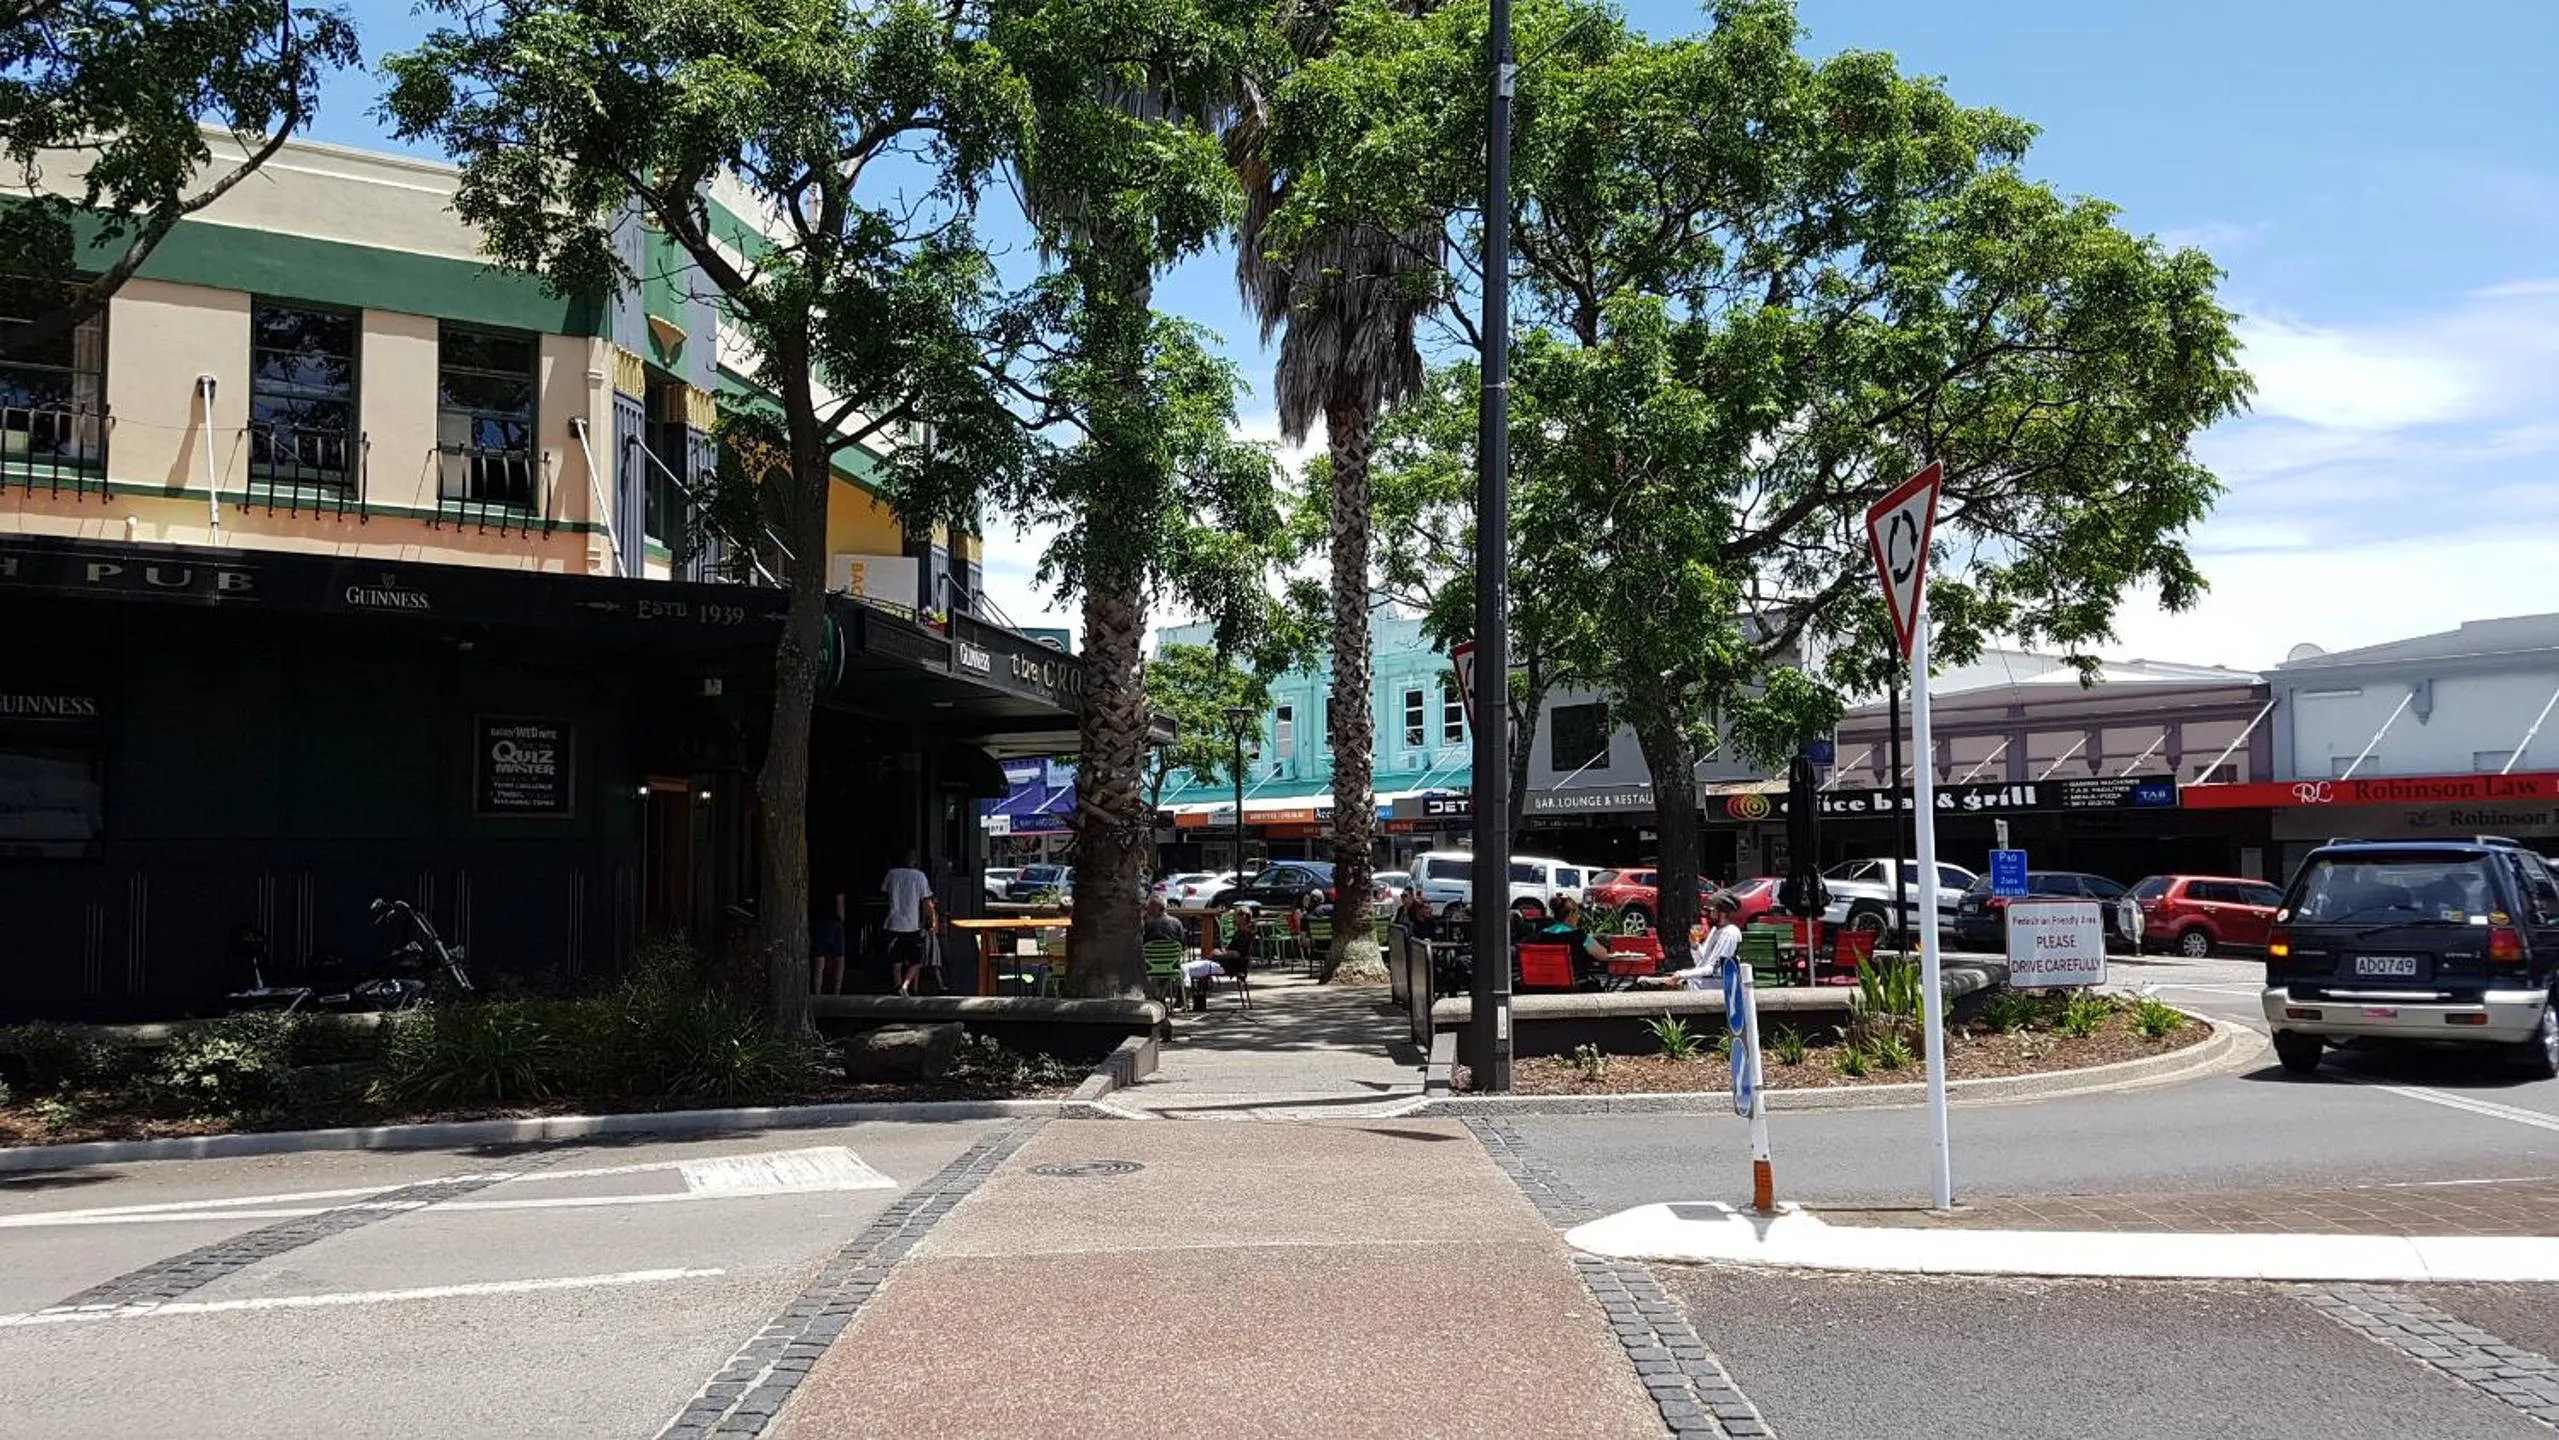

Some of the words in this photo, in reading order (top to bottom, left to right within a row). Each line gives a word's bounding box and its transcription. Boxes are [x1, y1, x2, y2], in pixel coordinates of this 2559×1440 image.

[87, 562, 256, 593] PUB
[345, 586, 431, 609] GUINNESS
[700, 604, 746, 625] 1939
[1010, 653, 1038, 681] the
[0, 695, 98, 716] UINNESS
[495, 763, 556, 775] MASTER
[1937, 793, 1955, 808] &
[1963, 786, 2037, 811] grill
[2140, 791, 2167, 800] TAB
[2354, 779, 2474, 801] Robinson
[2484, 776, 2539, 797] Law
[1604, 795, 1612, 806] &
[2450, 809, 2547, 828] Robinson
[2052, 916, 2078, 926] Friendly
[2037, 935, 2076, 948] PLEASE
[2011, 960, 2043, 973] DRIVE
[2045, 957, 2100, 972] CAREFULLY
